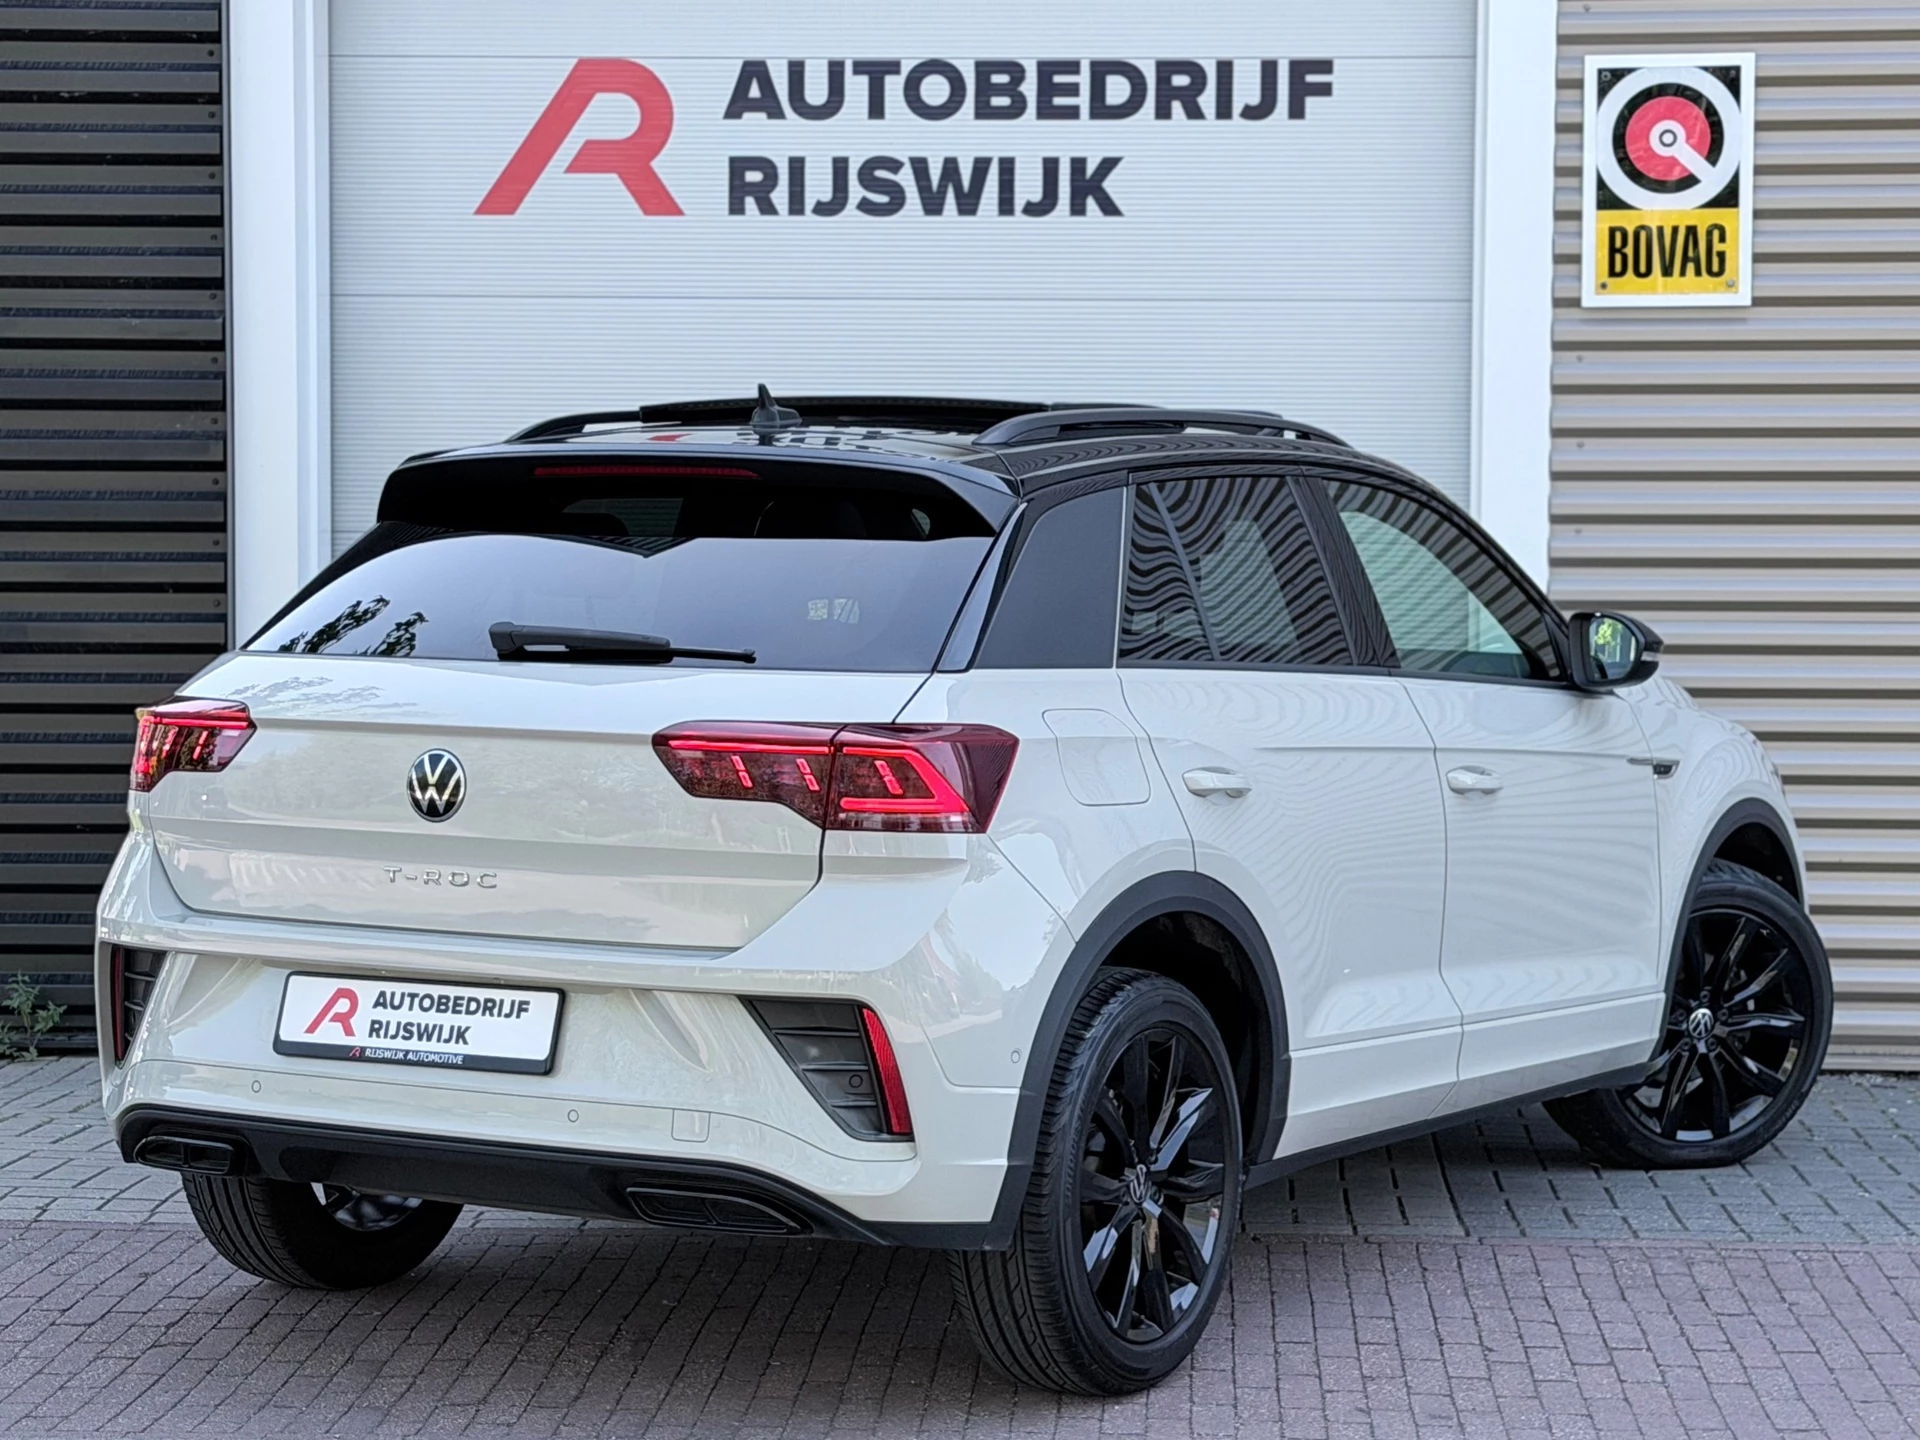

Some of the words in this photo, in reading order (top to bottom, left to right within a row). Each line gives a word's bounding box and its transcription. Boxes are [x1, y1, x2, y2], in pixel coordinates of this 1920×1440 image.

[723, 59, 1333, 121] AUTOBEDRIJF
[728, 156, 1125, 218] RIJSWIJK
[1607, 223, 1727, 279] BOVAG
[383, 866, 498, 889] T-ROC
[371, 990, 531, 1020] AUTOBEDRIJF
[367, 1019, 472, 1046] RIJSWIJK
[364, 1048, 405, 1061] RIJSWIJK
[406, 1051, 464, 1065] AUTOMOTIVE
